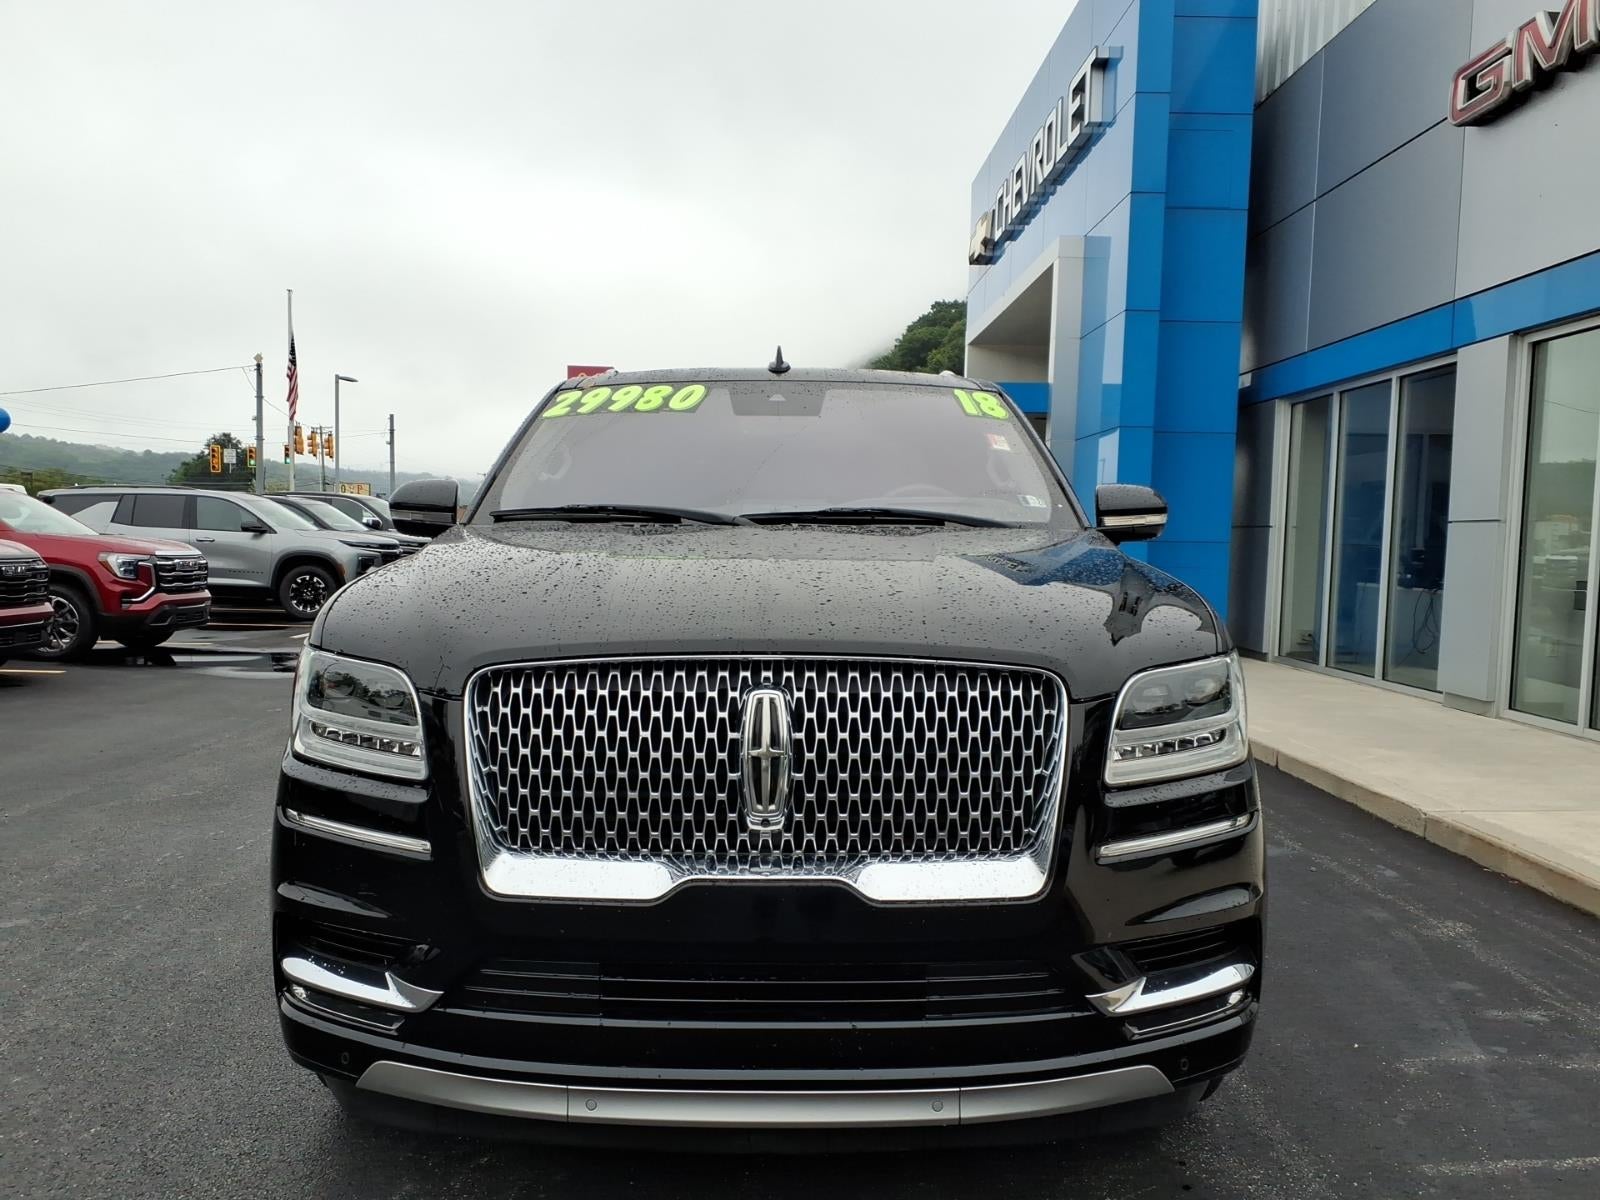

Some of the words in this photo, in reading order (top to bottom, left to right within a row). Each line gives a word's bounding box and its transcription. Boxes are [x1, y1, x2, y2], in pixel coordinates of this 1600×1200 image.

[1449, 0, 1600, 127] GM
[994, 45, 1124, 243] CHEVROLET
[542, 384, 706, 418] 29980
[953, 388, 1008, 420] 18
